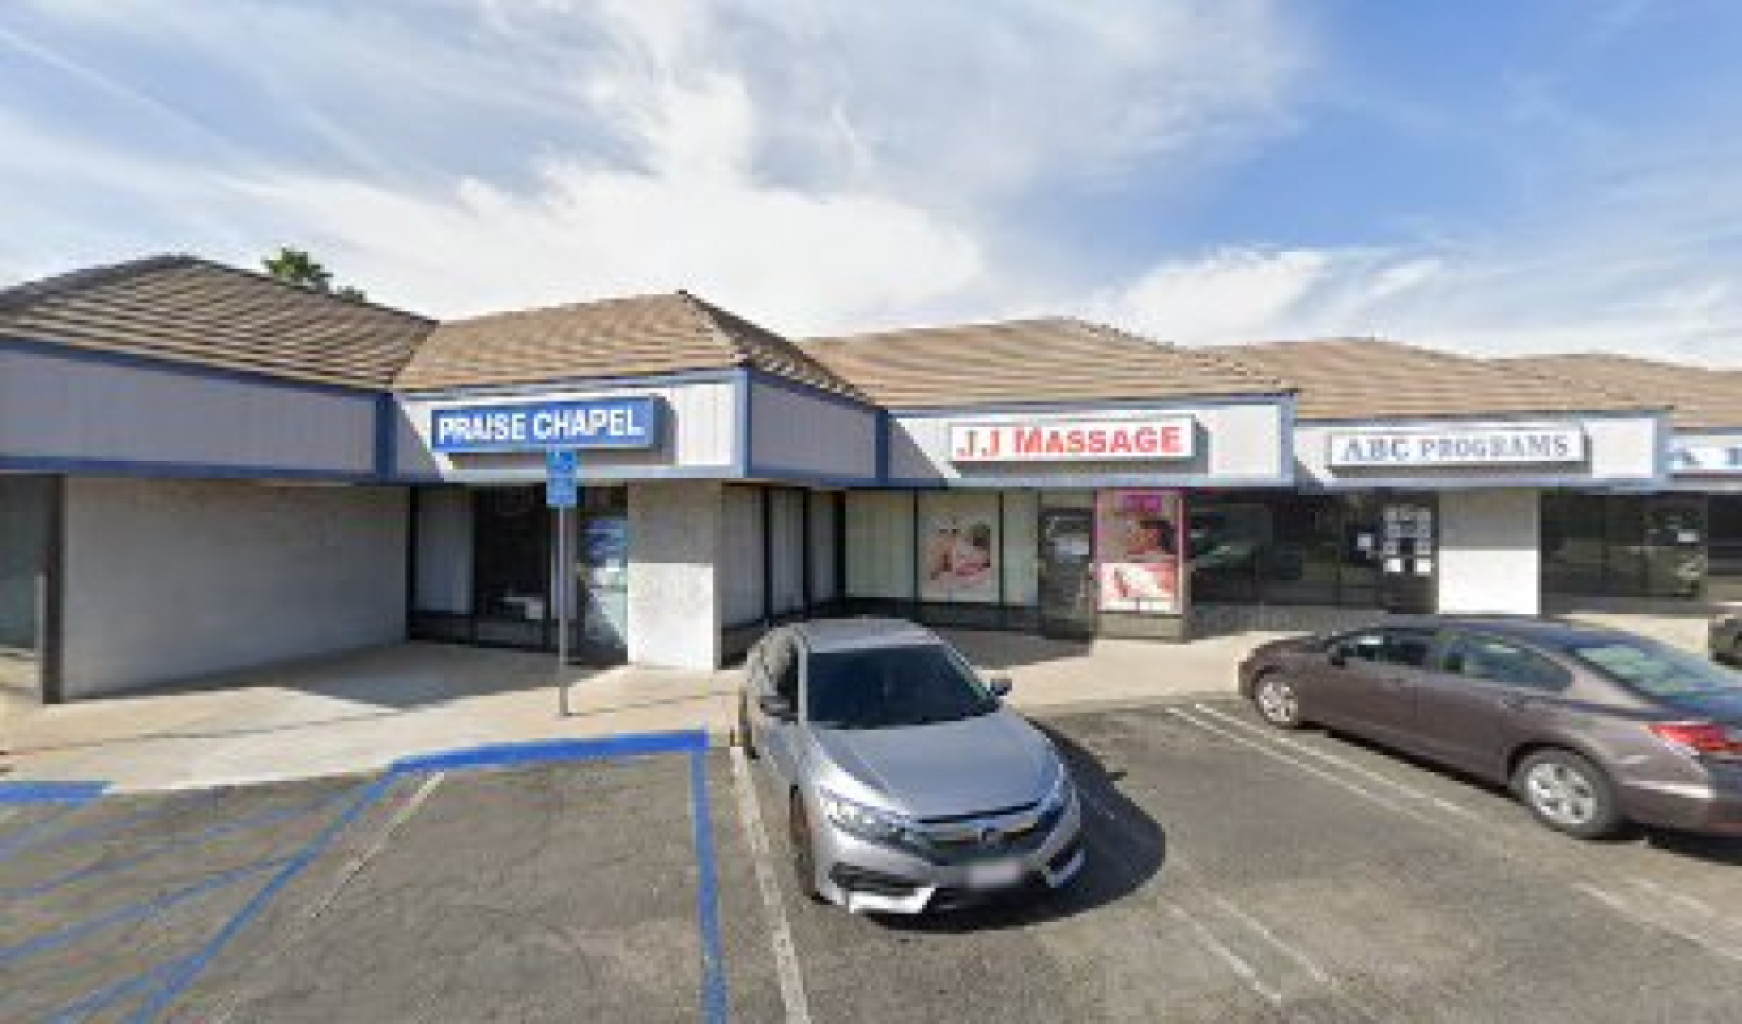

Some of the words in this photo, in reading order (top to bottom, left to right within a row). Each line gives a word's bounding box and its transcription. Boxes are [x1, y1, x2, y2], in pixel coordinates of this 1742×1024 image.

[438, 412, 527, 444] PRAISE
[532, 407, 646, 440] CHAPEL
[1013, 426, 1183, 455] MASSAGE
[1344, 437, 1411, 462] ABC
[1419, 434, 1569, 459] PROGRAMS
